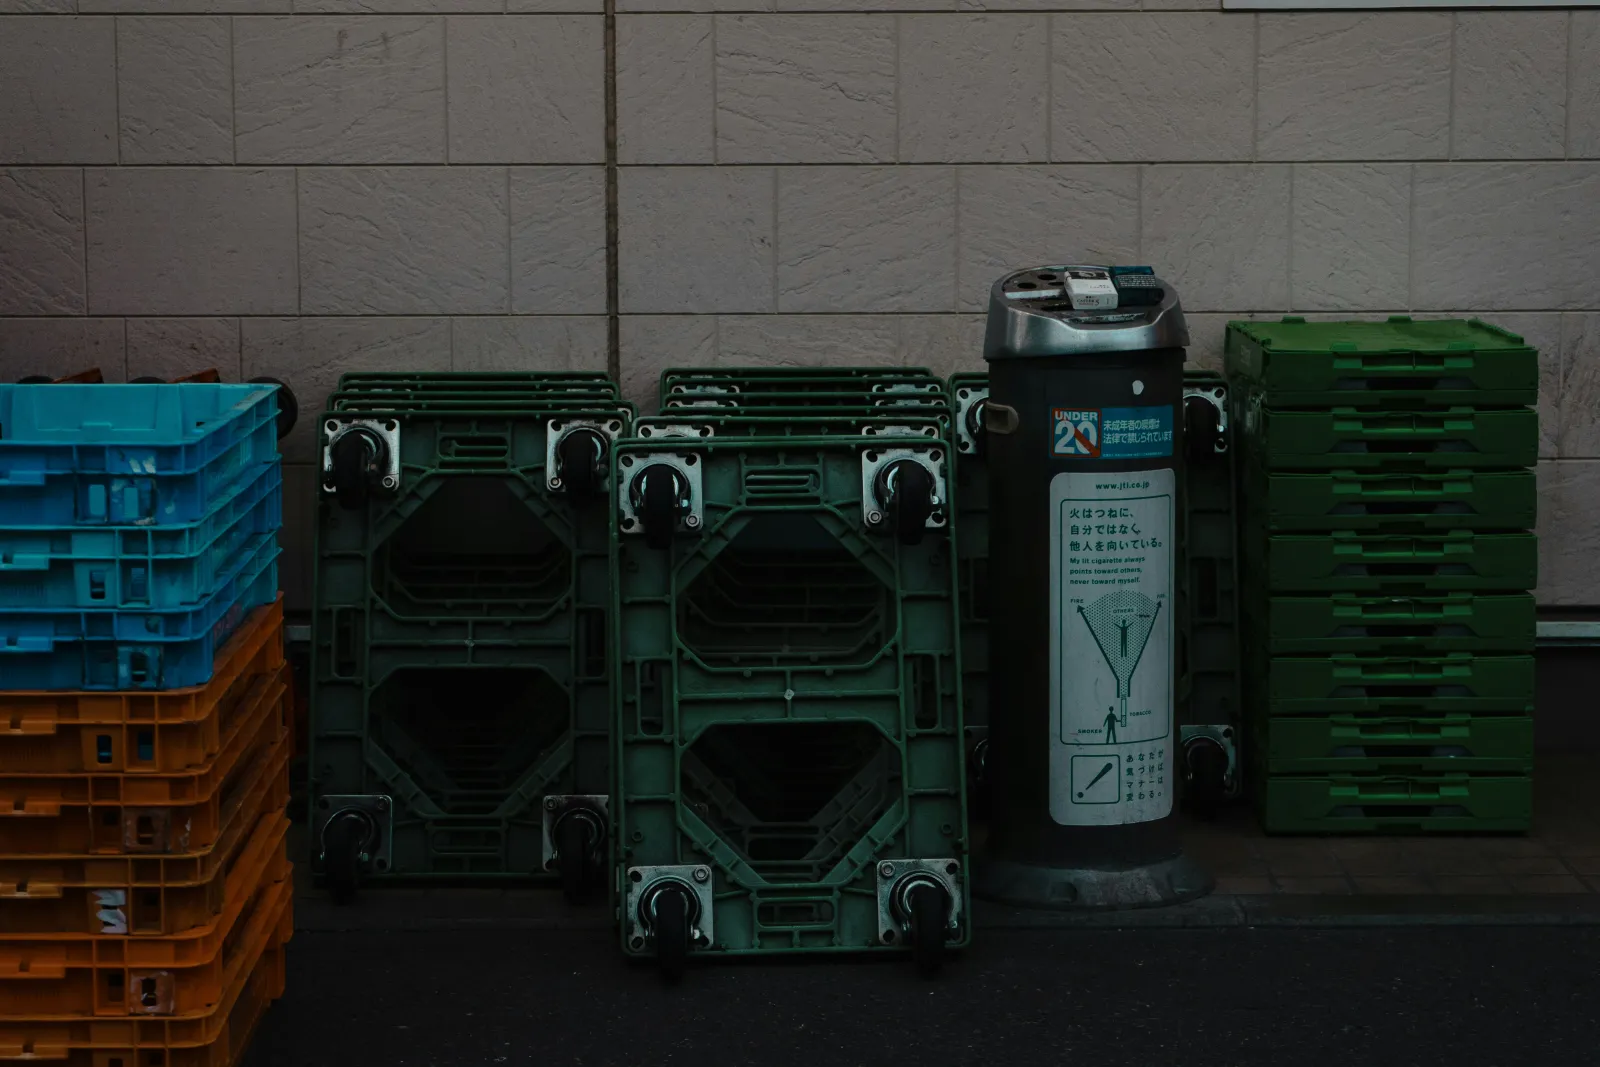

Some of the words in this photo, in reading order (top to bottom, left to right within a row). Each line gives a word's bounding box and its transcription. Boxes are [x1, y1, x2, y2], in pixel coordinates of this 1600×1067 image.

[1054, 411, 1098, 421] UNDER
[1054, 420, 1098, 455] 20
[1095, 481, 1150, 490] www.jti.co.jp
[1069, 508, 1134, 519] 火はつねに、
[1069, 537, 1162, 551] 他人を向いている。
[1069, 557, 1080, 565] My
[1091, 557, 1122, 565] cigarette
[1126, 749, 1164, 763] あなたが
[1126, 776, 1164, 789] マナーは
